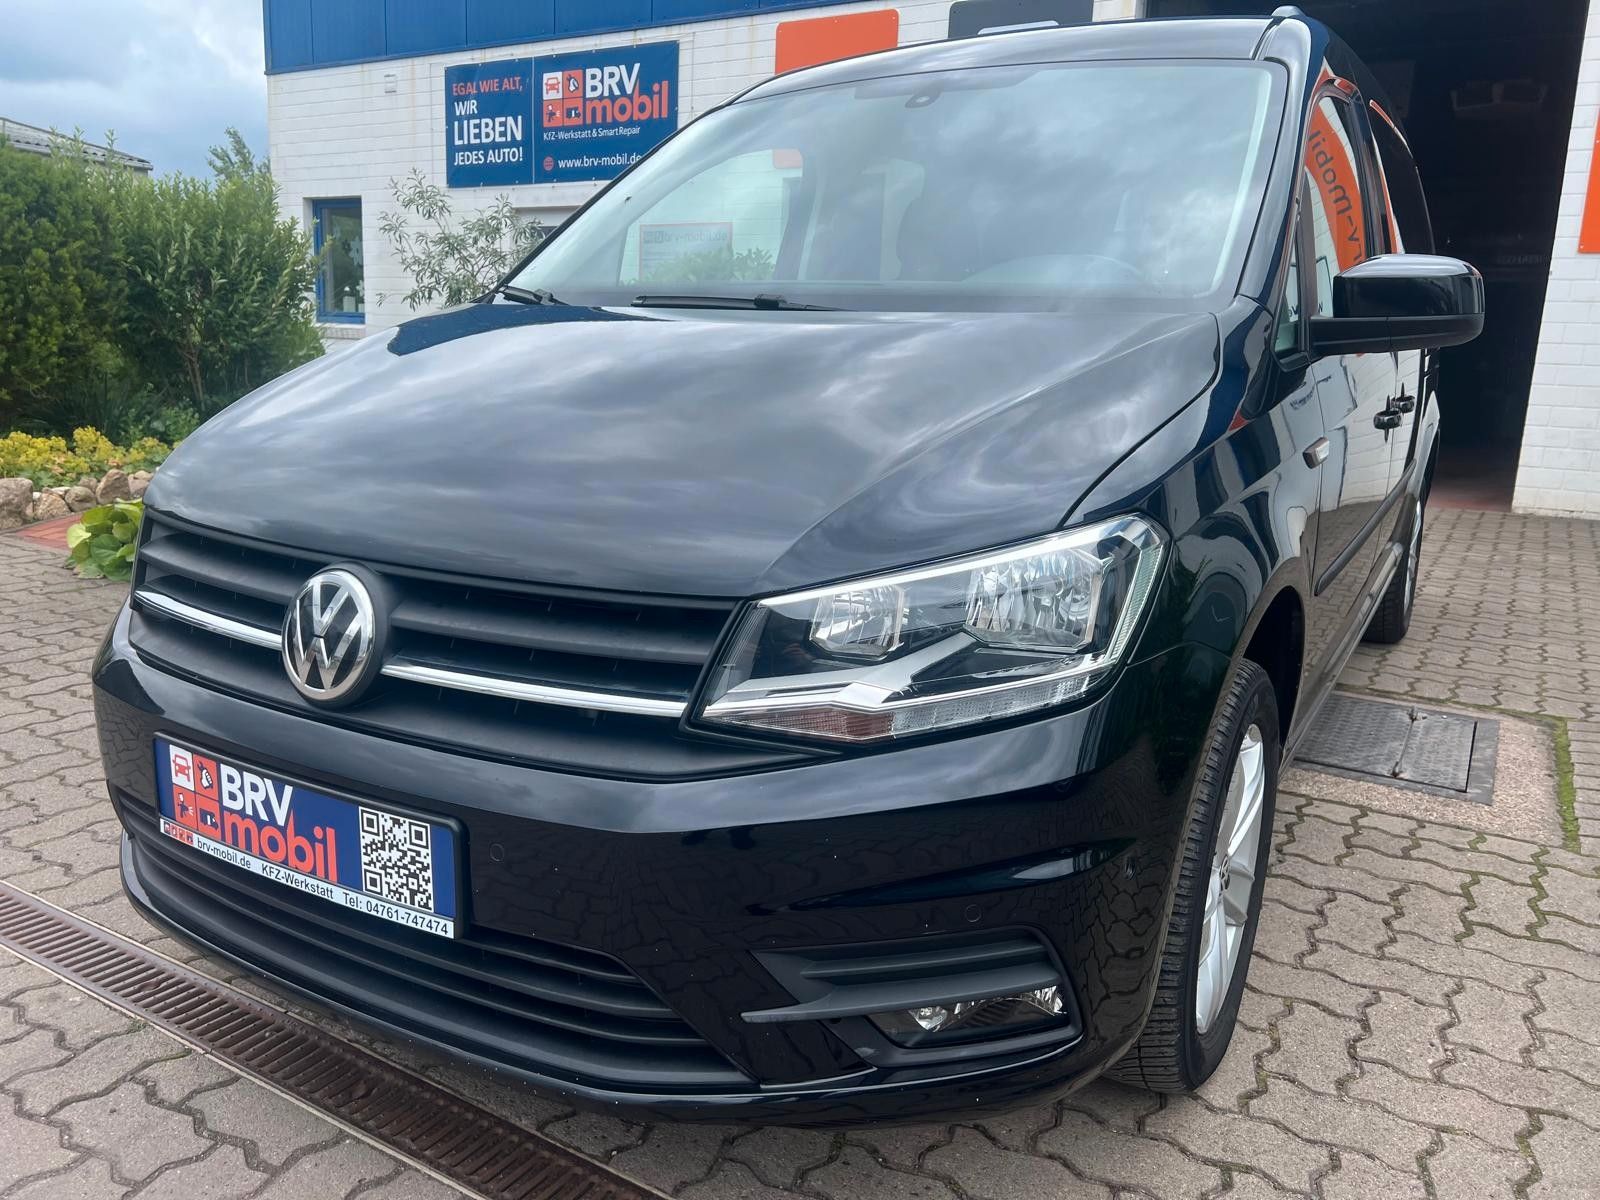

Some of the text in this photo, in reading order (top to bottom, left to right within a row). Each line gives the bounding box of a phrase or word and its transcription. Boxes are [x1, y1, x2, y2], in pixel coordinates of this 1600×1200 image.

[452, 77, 523, 96] EGAL WIE ALT,
[586, 63, 641, 98] BRV
[454, 99, 478, 116] WIR
[586, 80, 669, 124] mobil
[454, 115, 522, 146] LIEBEN
[454, 147, 523, 166] JEDES AUTO!
[220, 763, 293, 826] BRV
[224, 809, 337, 882] mobil
[197, 839, 449, 936] brv-mobil.de KFZ-Werkstatt Tel: 04761-747474
